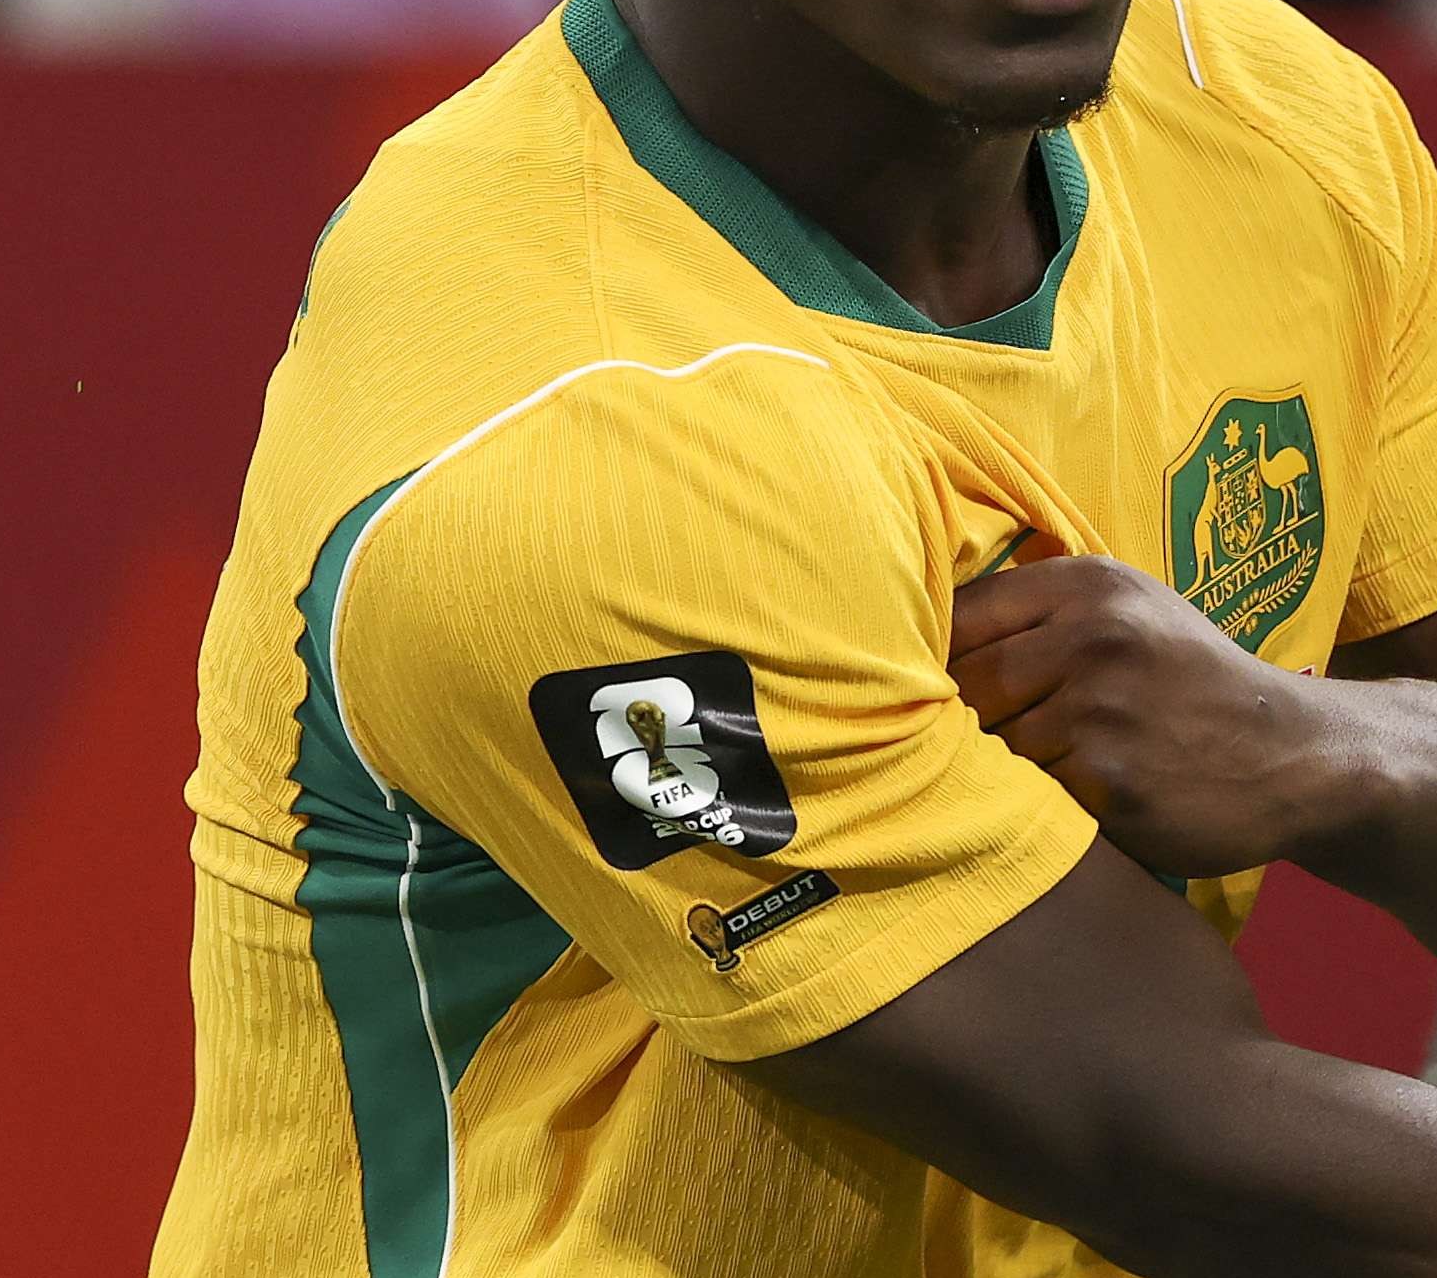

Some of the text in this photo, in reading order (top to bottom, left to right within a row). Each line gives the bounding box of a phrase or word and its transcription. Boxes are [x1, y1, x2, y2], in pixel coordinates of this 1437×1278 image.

[1202, 532, 1301, 616] AUSTRALIA
[650, 782, 694, 809] FIFA
[700, 807, 733, 829] CUP
[726, 874, 814, 932] DEBUT
